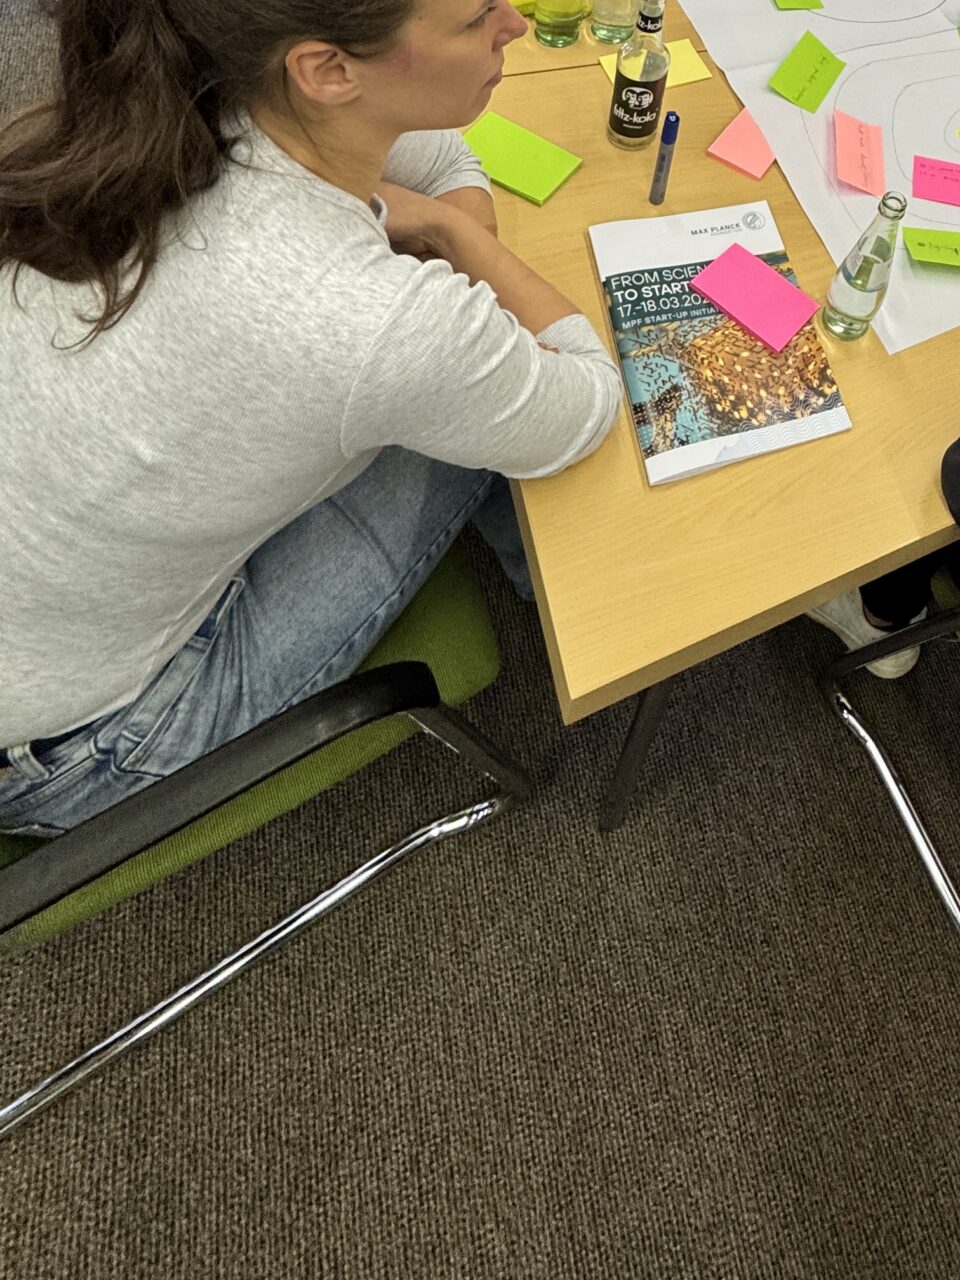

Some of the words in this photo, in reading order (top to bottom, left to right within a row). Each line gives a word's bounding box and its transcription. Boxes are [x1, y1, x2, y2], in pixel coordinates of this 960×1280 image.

[613, 104, 656, 124] fritz-kola
[711, 223, 741, 232] PLANCK
[611, 271, 660, 289] FROM
[662, 265, 708, 282] SCIEN
[614, 288, 638, 303] TO
[642, 281, 691, 299] START
[617, 293, 710, 318] 17.-18.03.202
[621, 318, 644, 329] MPF
[645, 311, 688, 324] START-UP
[690, 306, 720, 317] INITIAT
